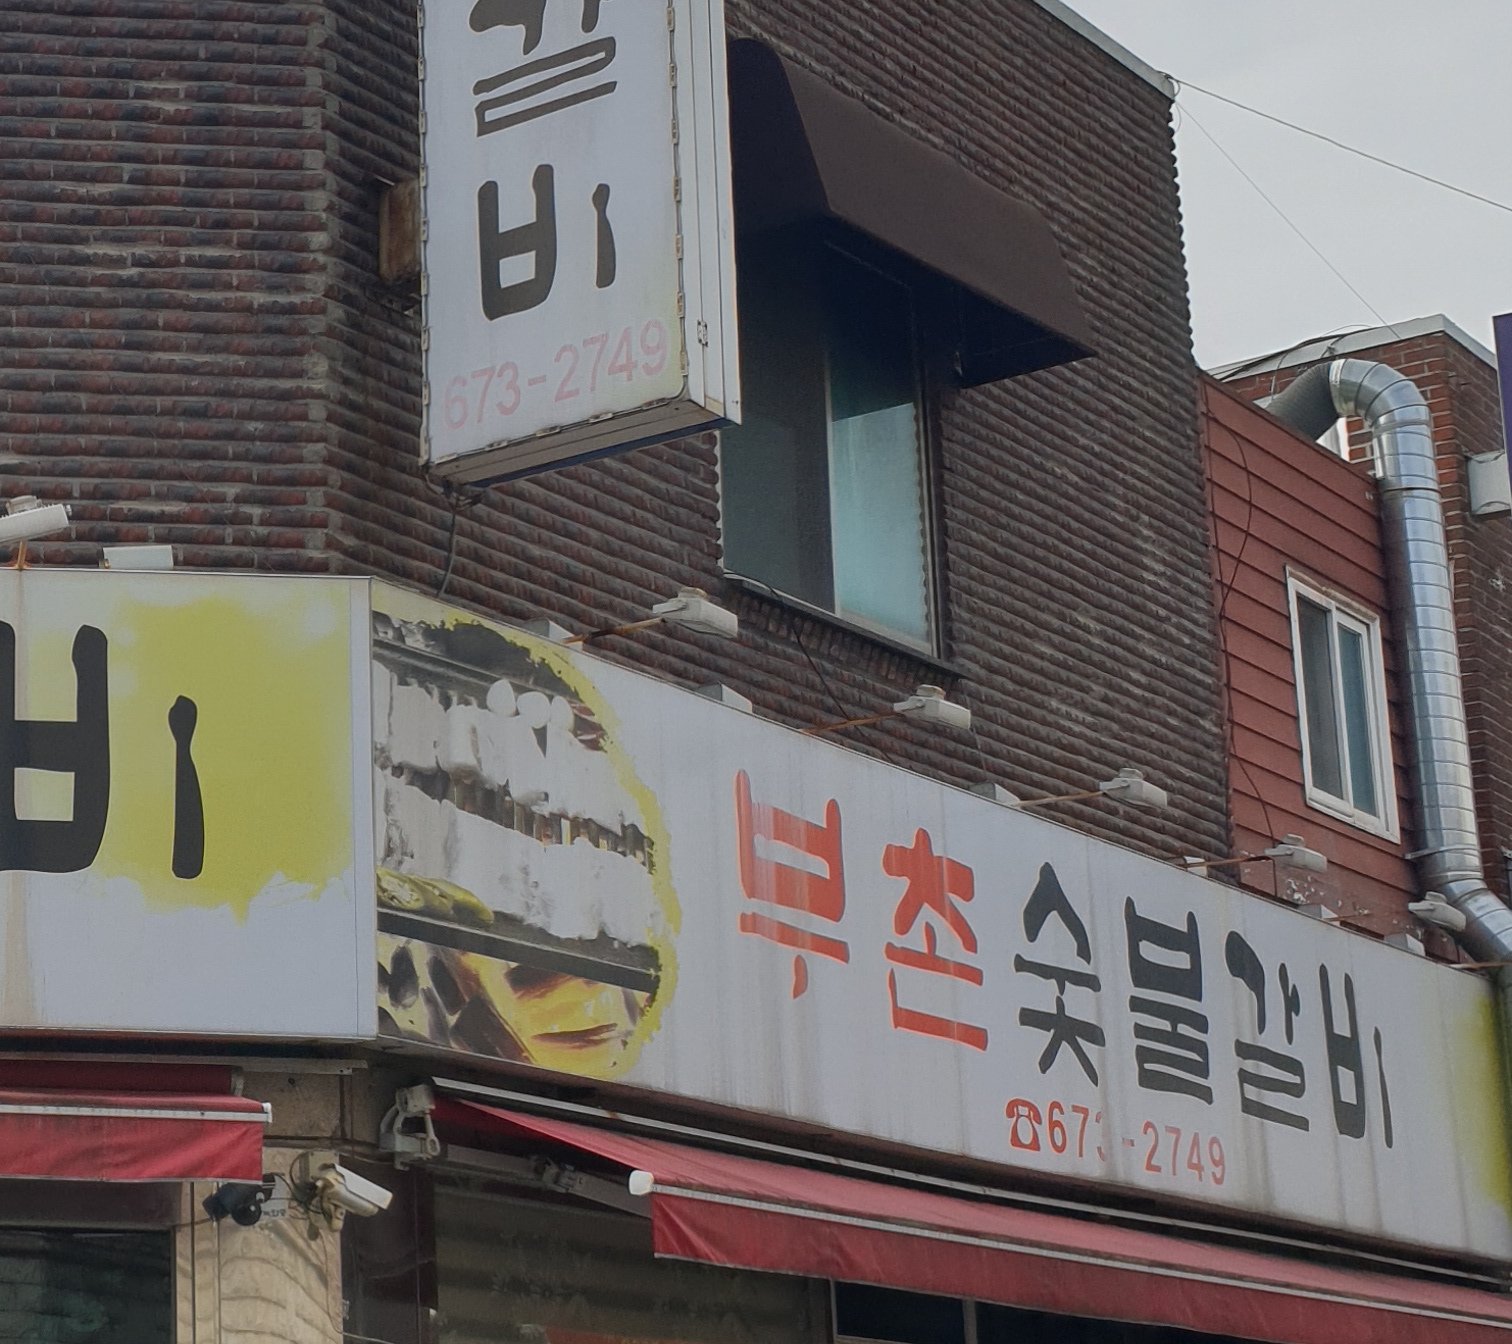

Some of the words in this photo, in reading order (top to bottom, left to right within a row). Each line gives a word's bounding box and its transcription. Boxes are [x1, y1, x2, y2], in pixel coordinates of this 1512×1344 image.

[444, 319, 667, 429] 673-2749
[734, 769, 989, 1051] 부촌
[1012, 861, 1394, 1150] 숯불갈비
